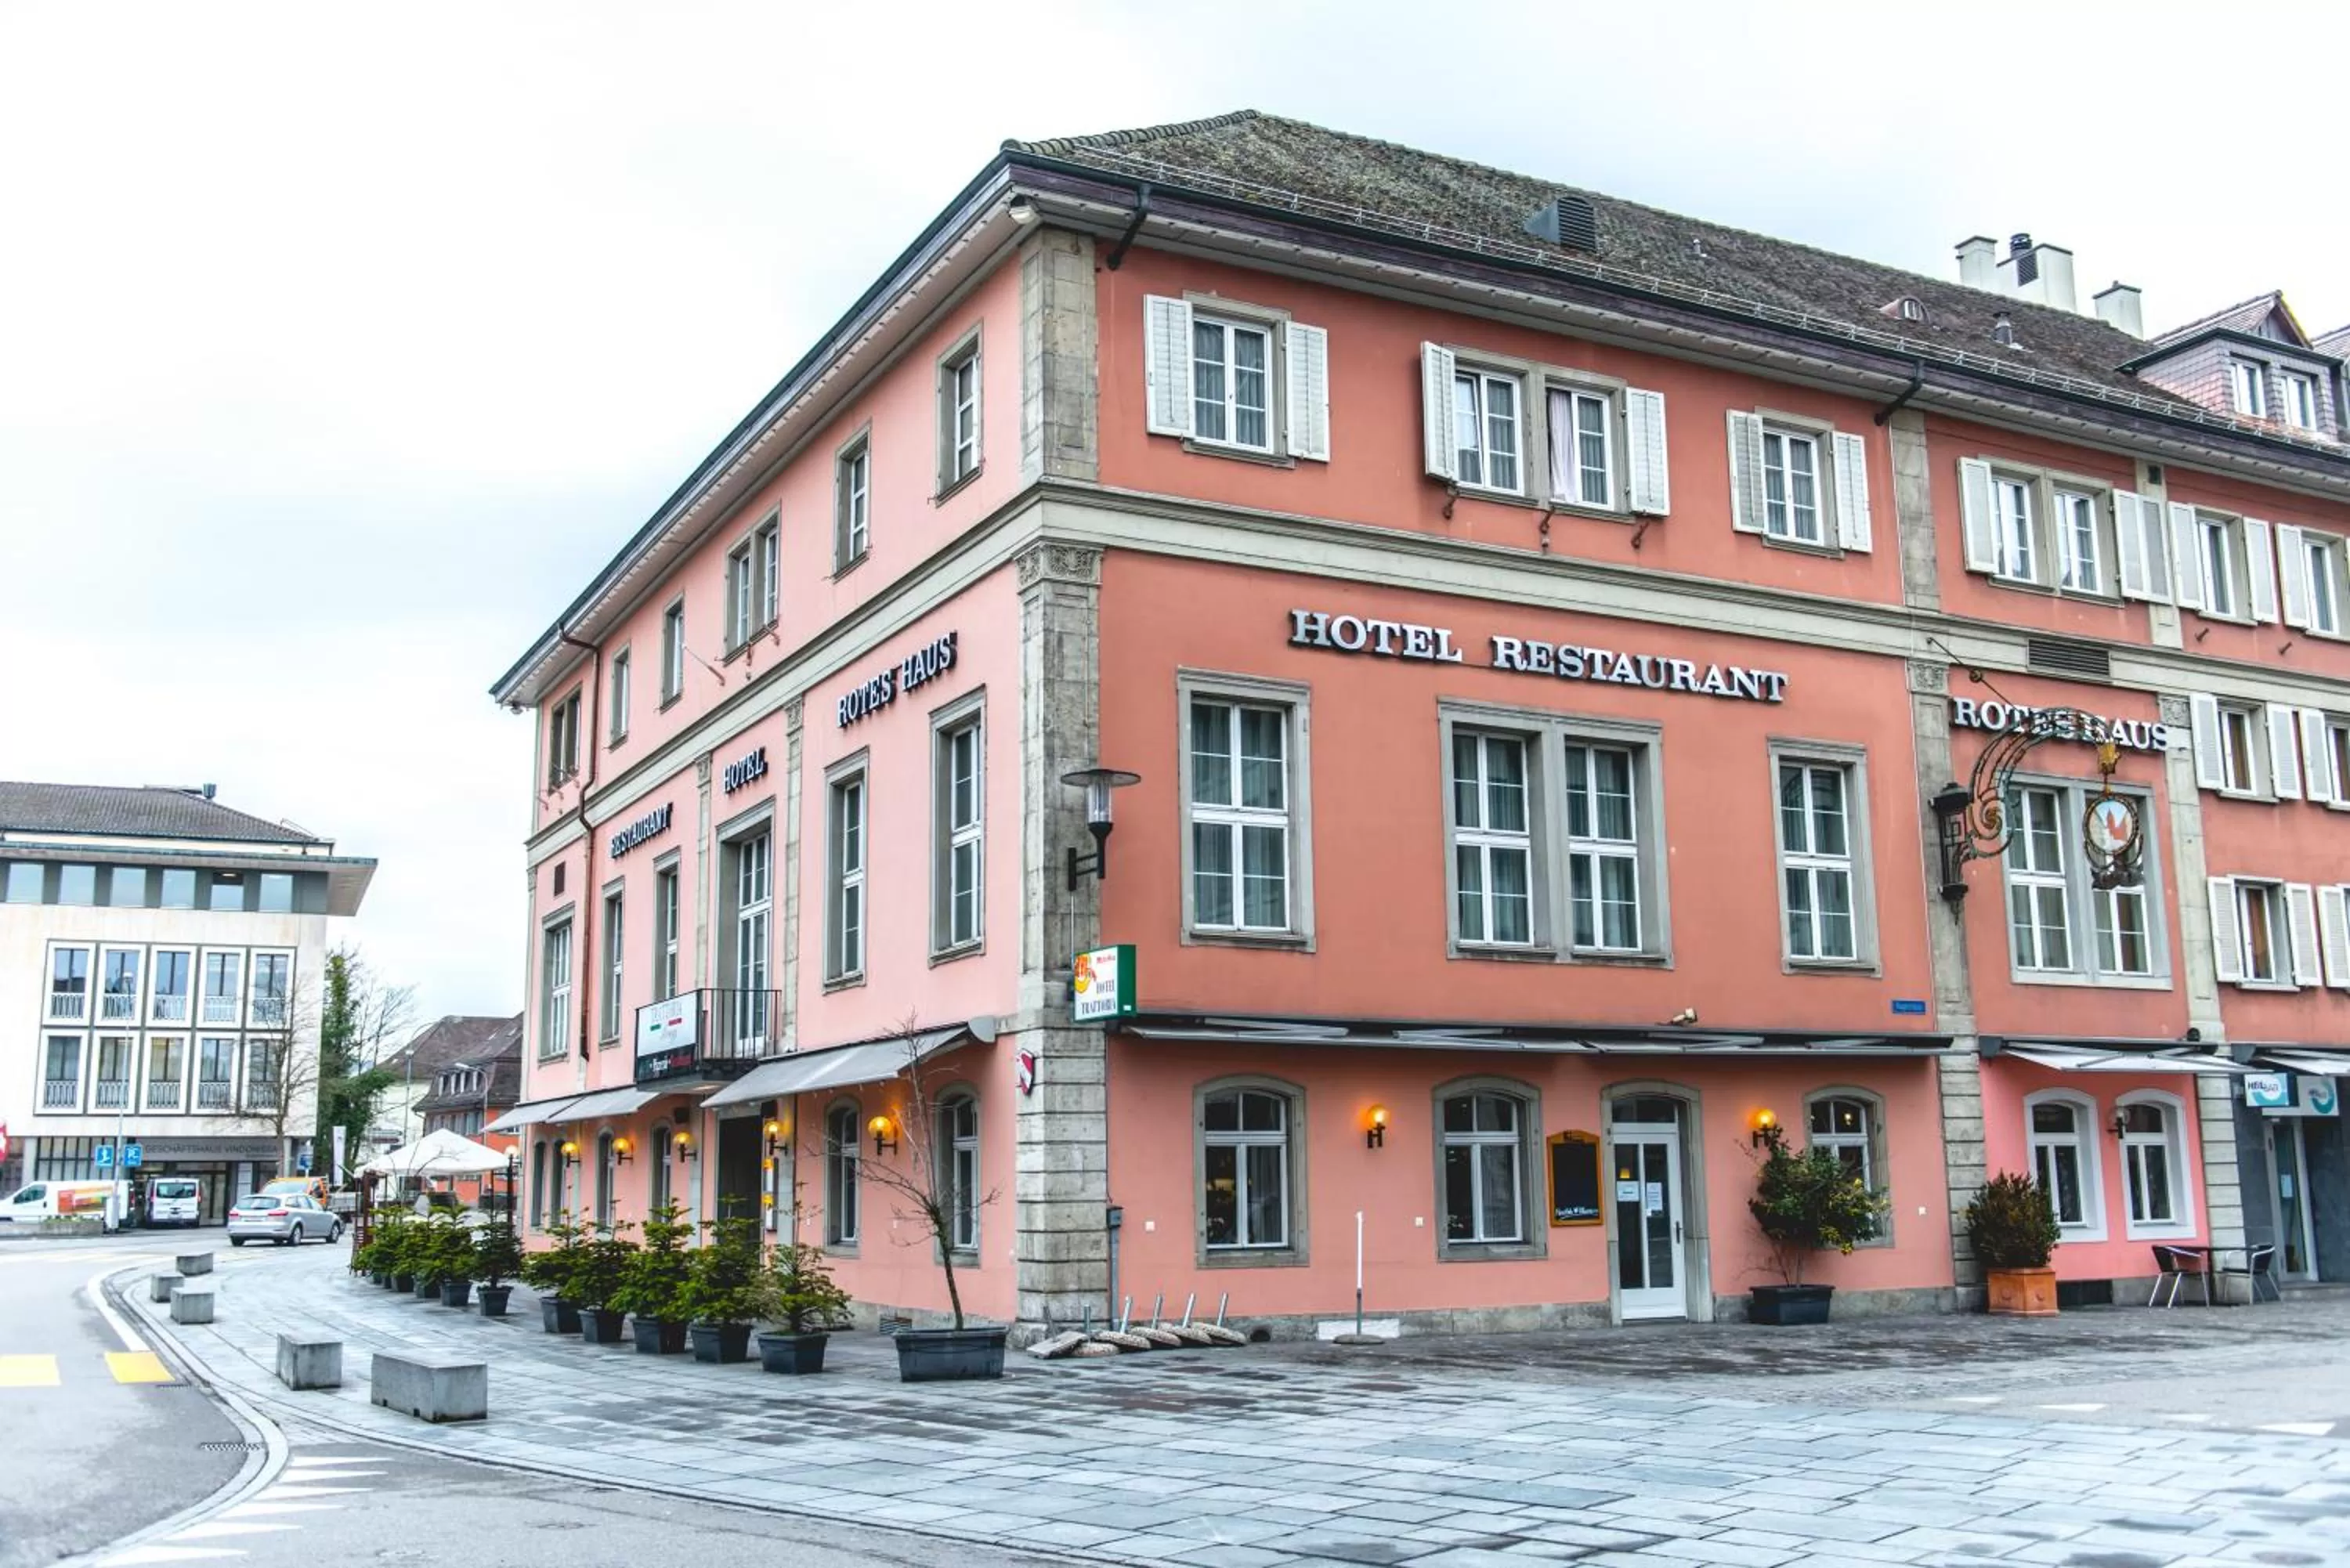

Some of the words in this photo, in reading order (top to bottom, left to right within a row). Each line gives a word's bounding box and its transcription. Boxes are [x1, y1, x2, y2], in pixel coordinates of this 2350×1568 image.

[836, 669, 896, 728] ROTES
[902, 631, 957, 692] HAUS
[1289, 609, 1462, 663] HOTEL
[1491, 634, 1789, 703] RESTAURANT
[723, 746, 768, 793] HOTEL
[609, 803, 673, 859] RESTAURANT
